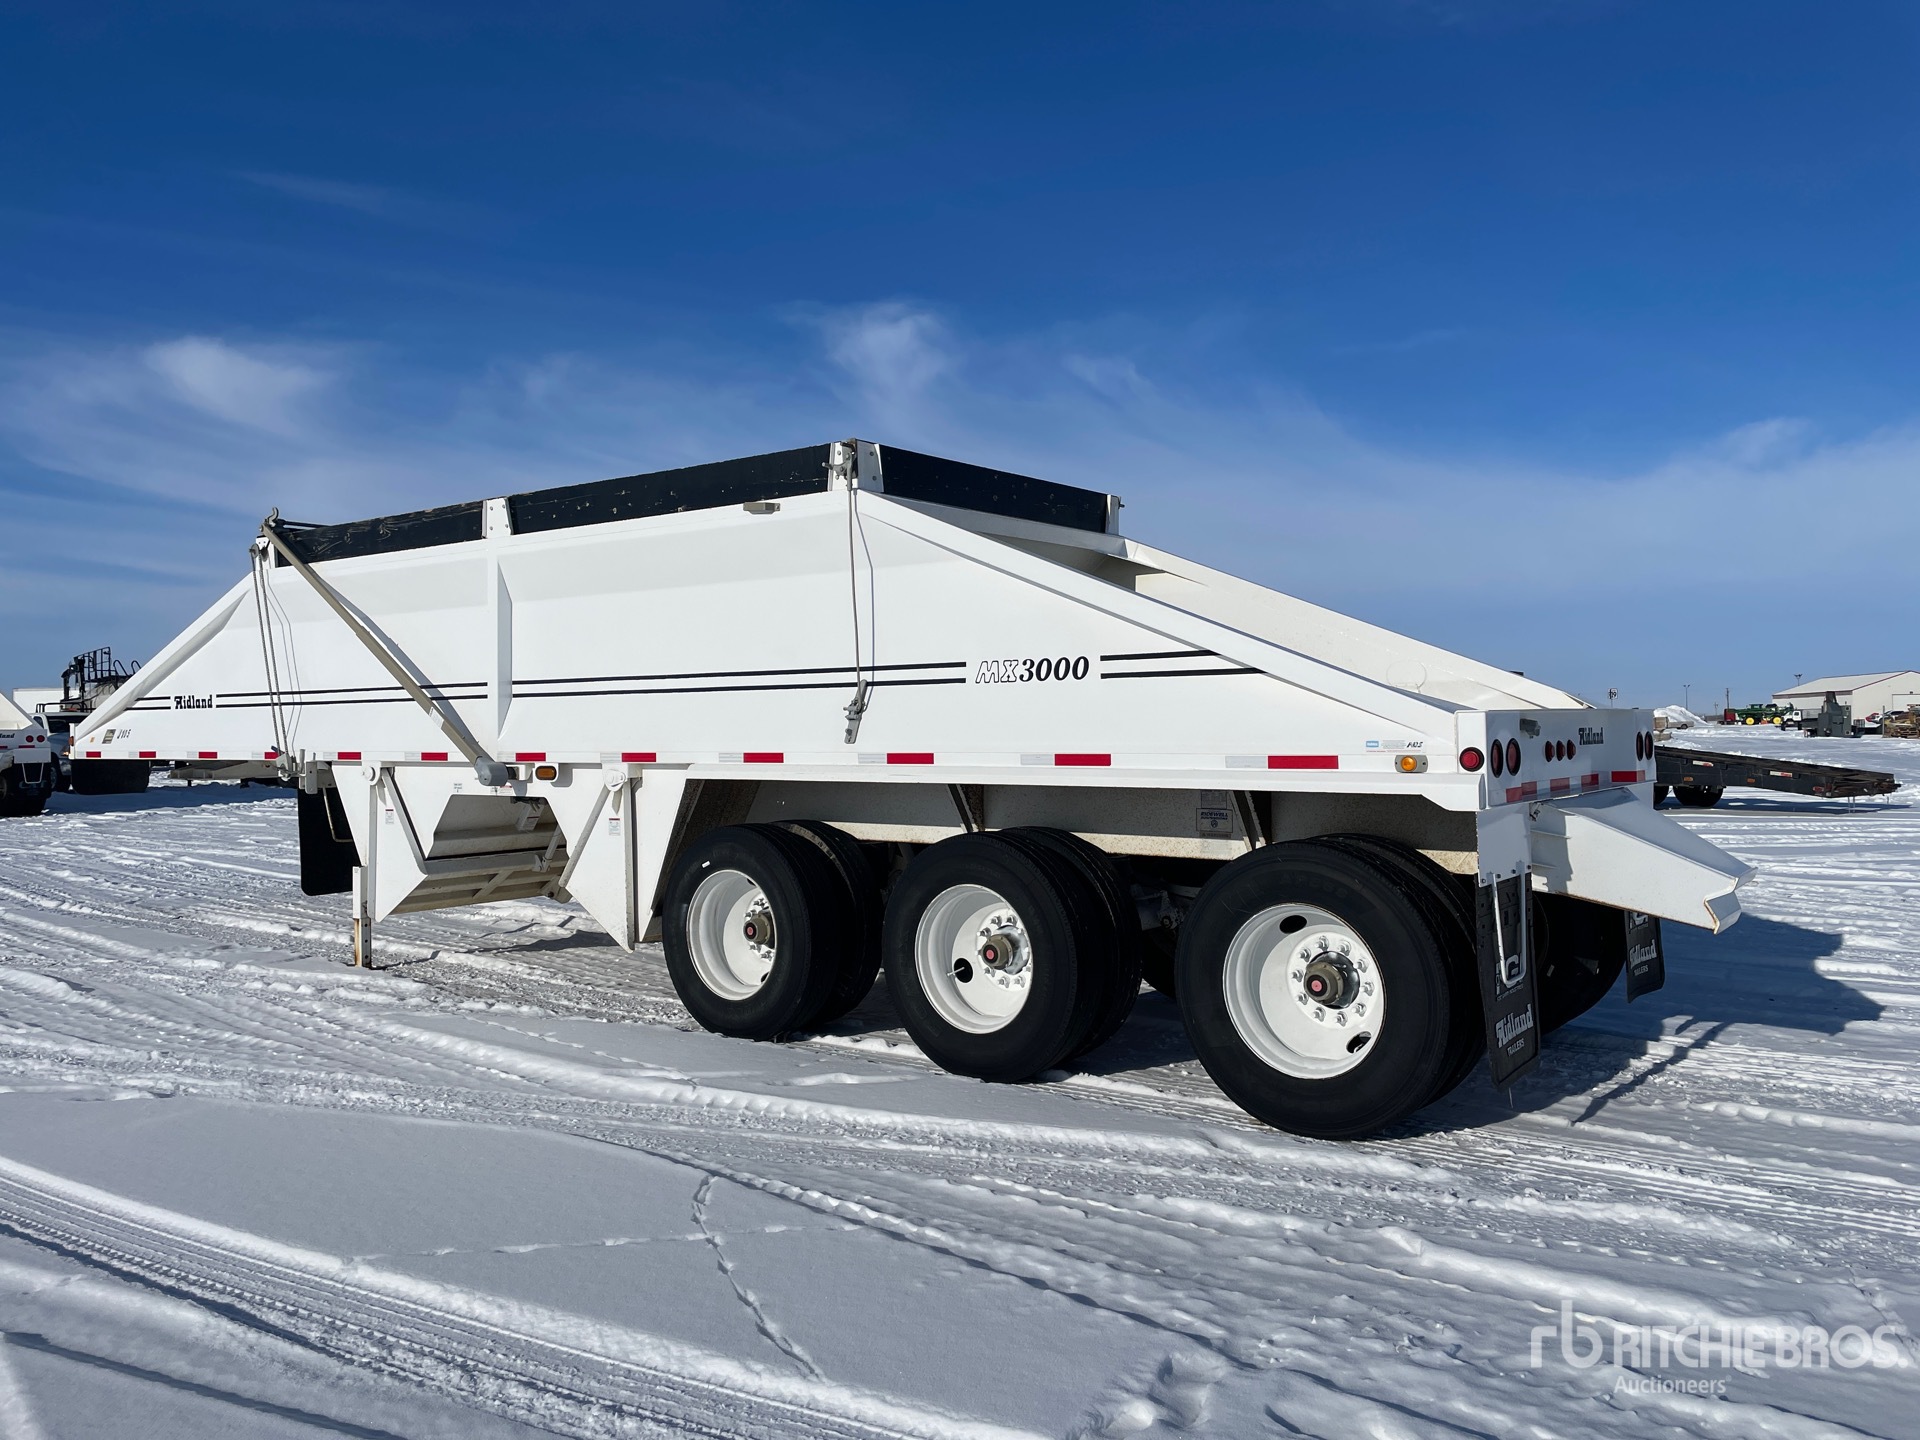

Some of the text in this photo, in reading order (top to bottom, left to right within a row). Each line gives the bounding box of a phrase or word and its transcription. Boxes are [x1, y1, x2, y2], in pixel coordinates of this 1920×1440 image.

[975, 655, 1089, 684] MX3000
[174, 694, 213, 709] Midland
[1578, 727, 1604, 745] Midland
